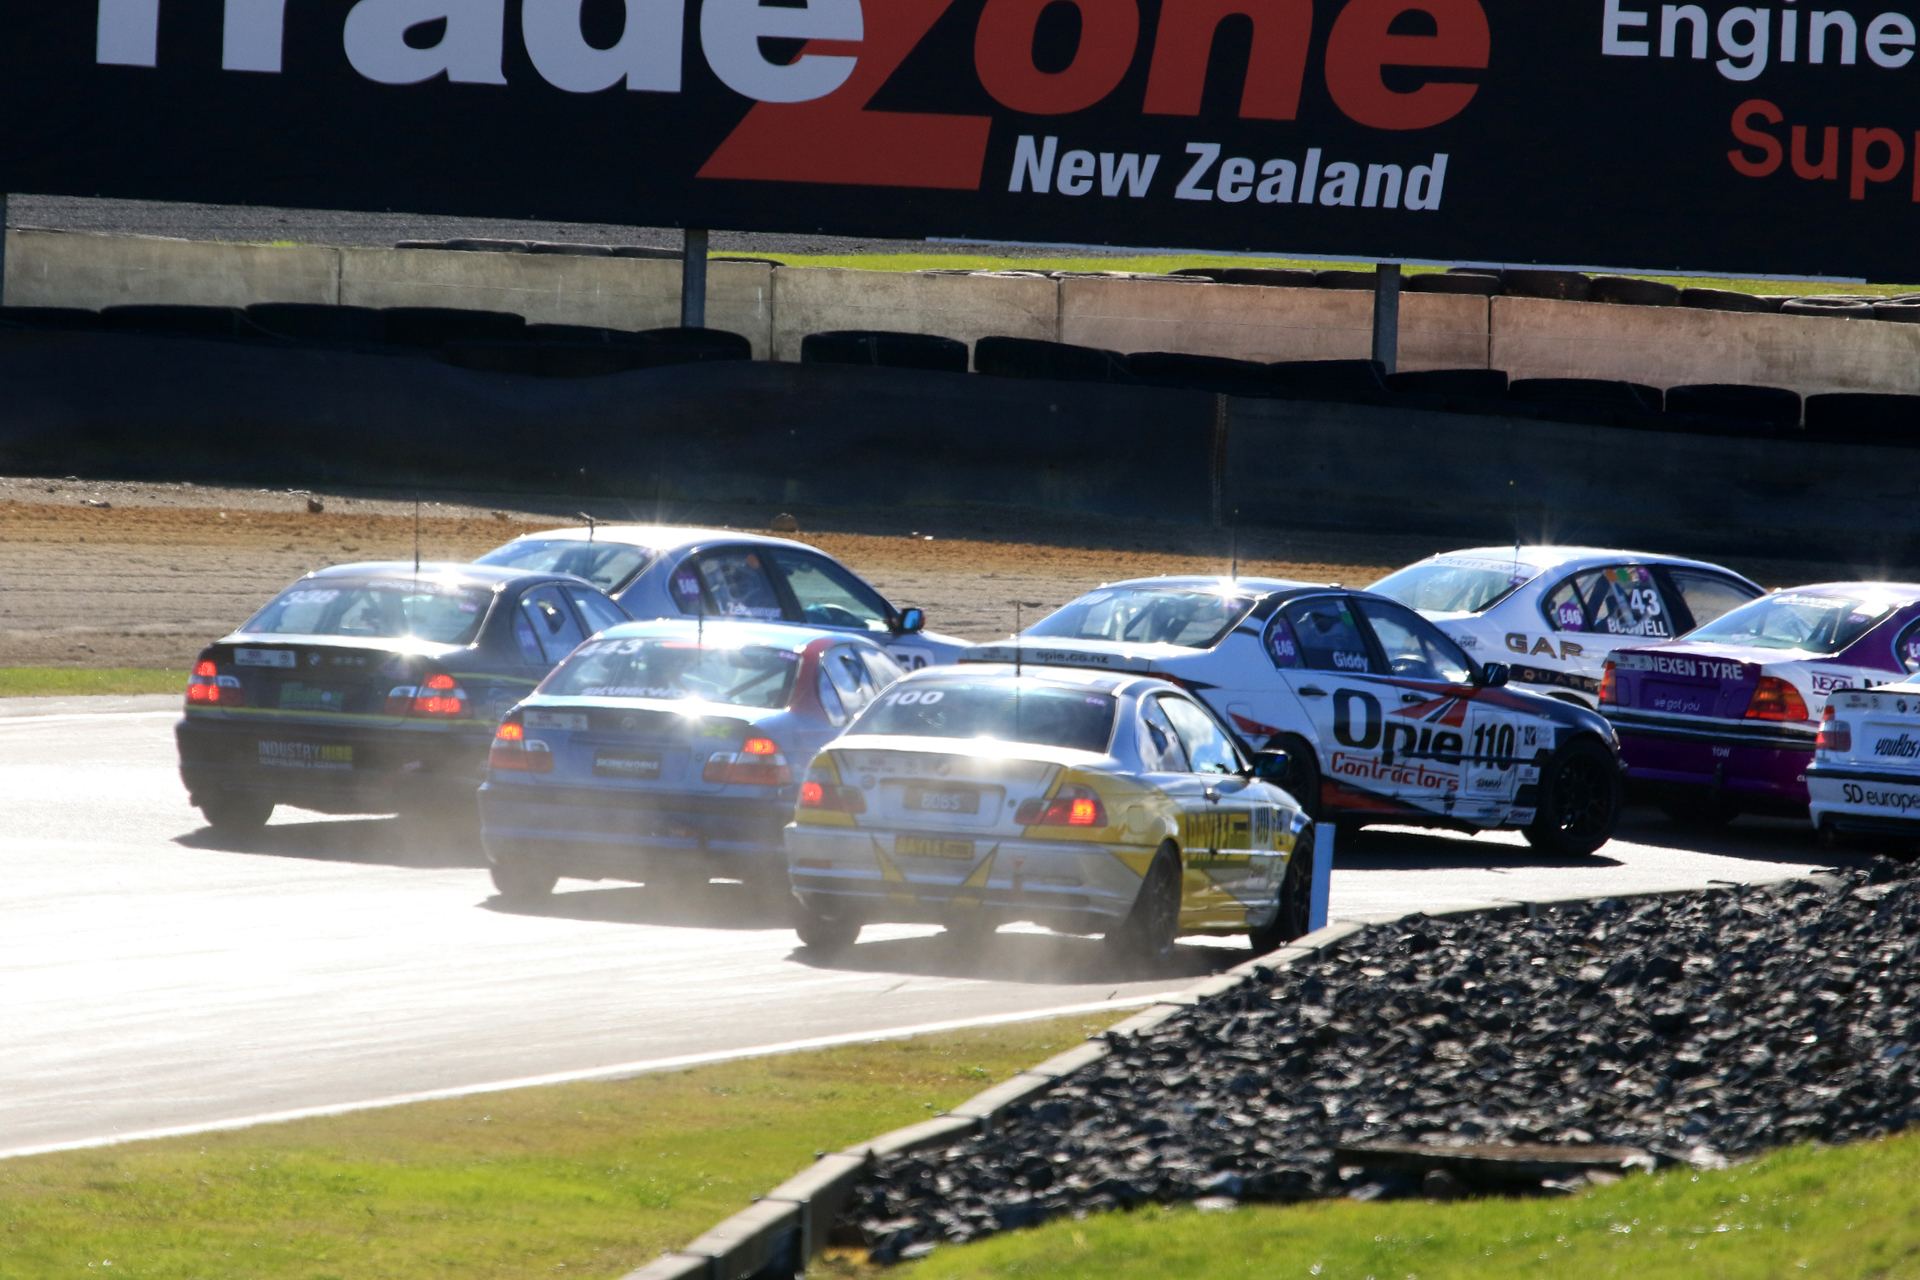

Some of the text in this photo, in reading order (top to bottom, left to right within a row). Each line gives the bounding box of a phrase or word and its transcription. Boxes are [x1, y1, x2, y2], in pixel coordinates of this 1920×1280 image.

[1601, 0, 1917, 81] Engine
[1007, 134, 1449, 211] New Zealand
[1630, 588, 1662, 616] 43
[1559, 608, 1583, 627] E46
[1273, 639, 1296, 658] E46
[1332, 650, 1369, 672] Giddy
[1649, 655, 1744, 681] NEXEN TYRE
[884, 691, 945, 707] 100
[1666, 698, 1682, 711] got
[1682, 702, 1700, 713] you
[1332, 687, 1463, 767] Opie
[258, 740, 320, 760] INDUSTRY
[1474, 723, 1515, 771] 110
[1712, 746, 1730, 758] TOW
[1331, 752, 1460, 792] Contractors
[1843, 783, 1920, 813] SD europe
